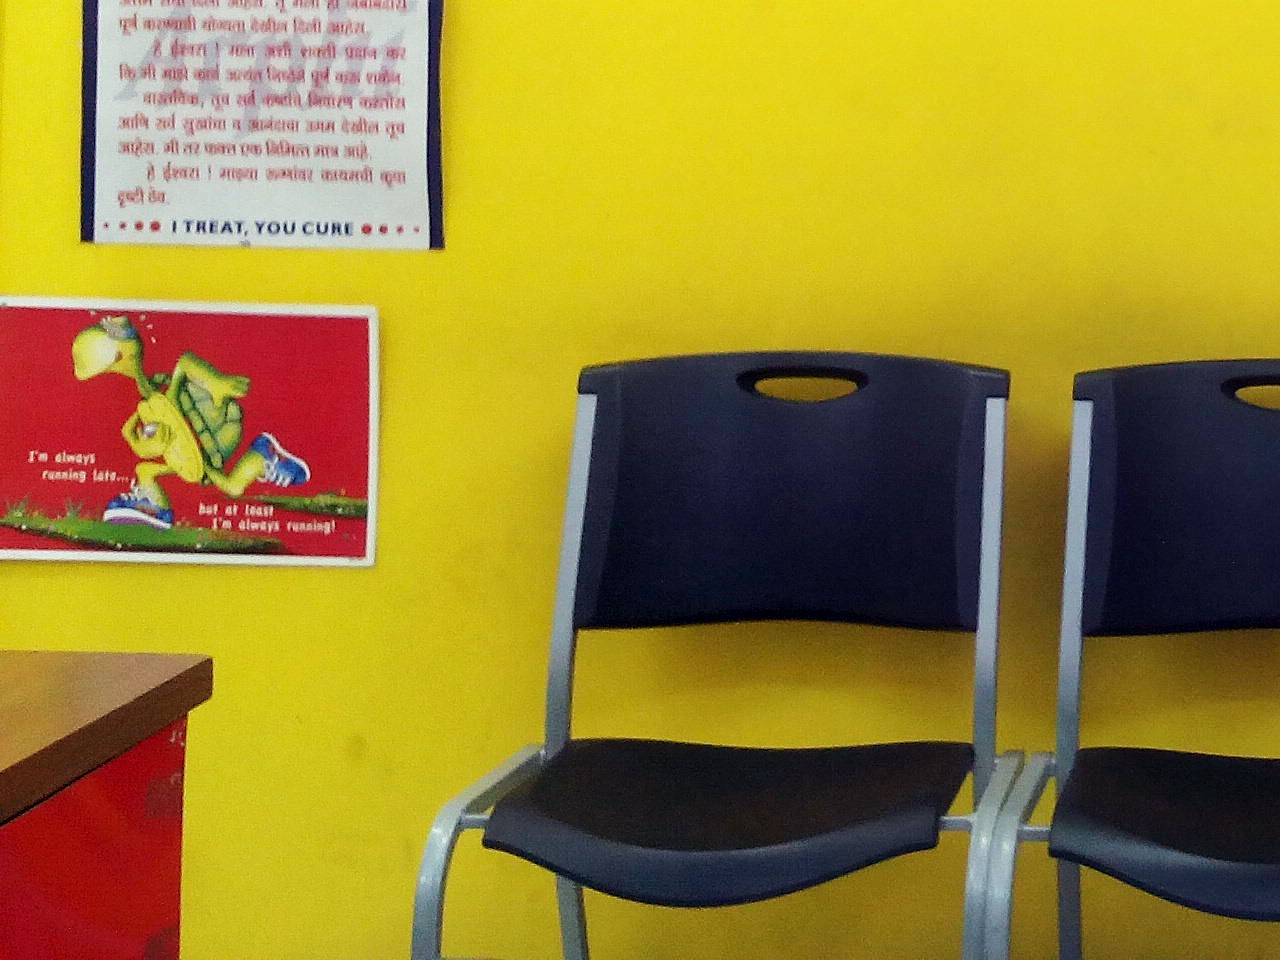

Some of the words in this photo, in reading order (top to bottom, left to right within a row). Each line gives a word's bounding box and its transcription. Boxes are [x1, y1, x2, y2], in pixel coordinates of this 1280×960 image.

[185, 220, 248, 236] TREAT,
[254, 222, 296, 235] YOU
[302, 222, 354, 236] CURE
[28, 450, 48, 462] I'm
[55, 452, 96, 464] always
[42, 469, 87, 482] running
[198, 503, 219, 516] but
[225, 504, 239, 516] at
[245, 504, 274, 517] least
[212, 518, 232, 531] I'm
[239, 519, 280, 533] always
[286, 520, 336, 534] running!
